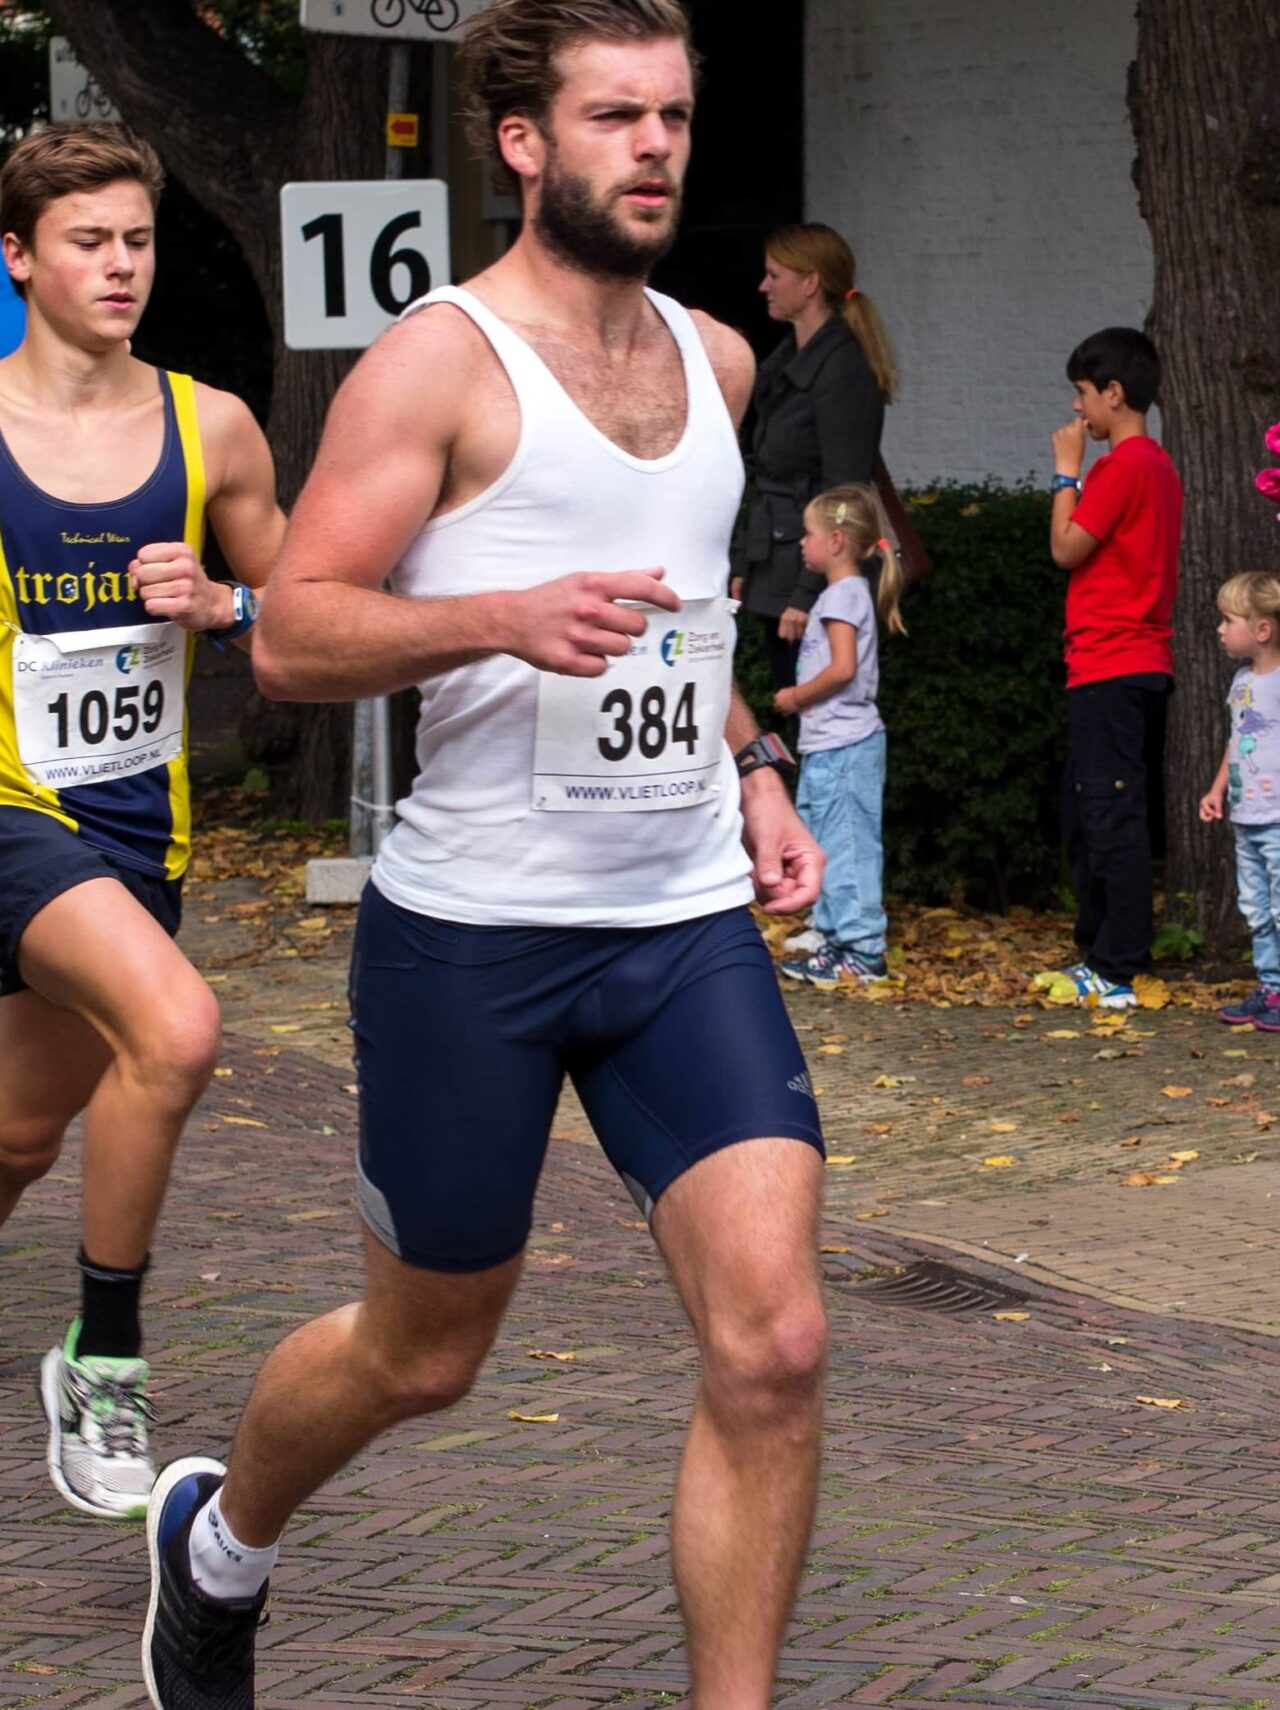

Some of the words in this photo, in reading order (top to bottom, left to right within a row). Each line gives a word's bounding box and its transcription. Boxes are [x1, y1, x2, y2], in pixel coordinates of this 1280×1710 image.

[300, 210, 431, 320] 16
[18, 661, 37, 672] DC
[47, 679, 165, 748] 1059
[597, 681, 700, 762] 384
[44, 750, 162, 780] WWW.VLIETLOOP.NL
